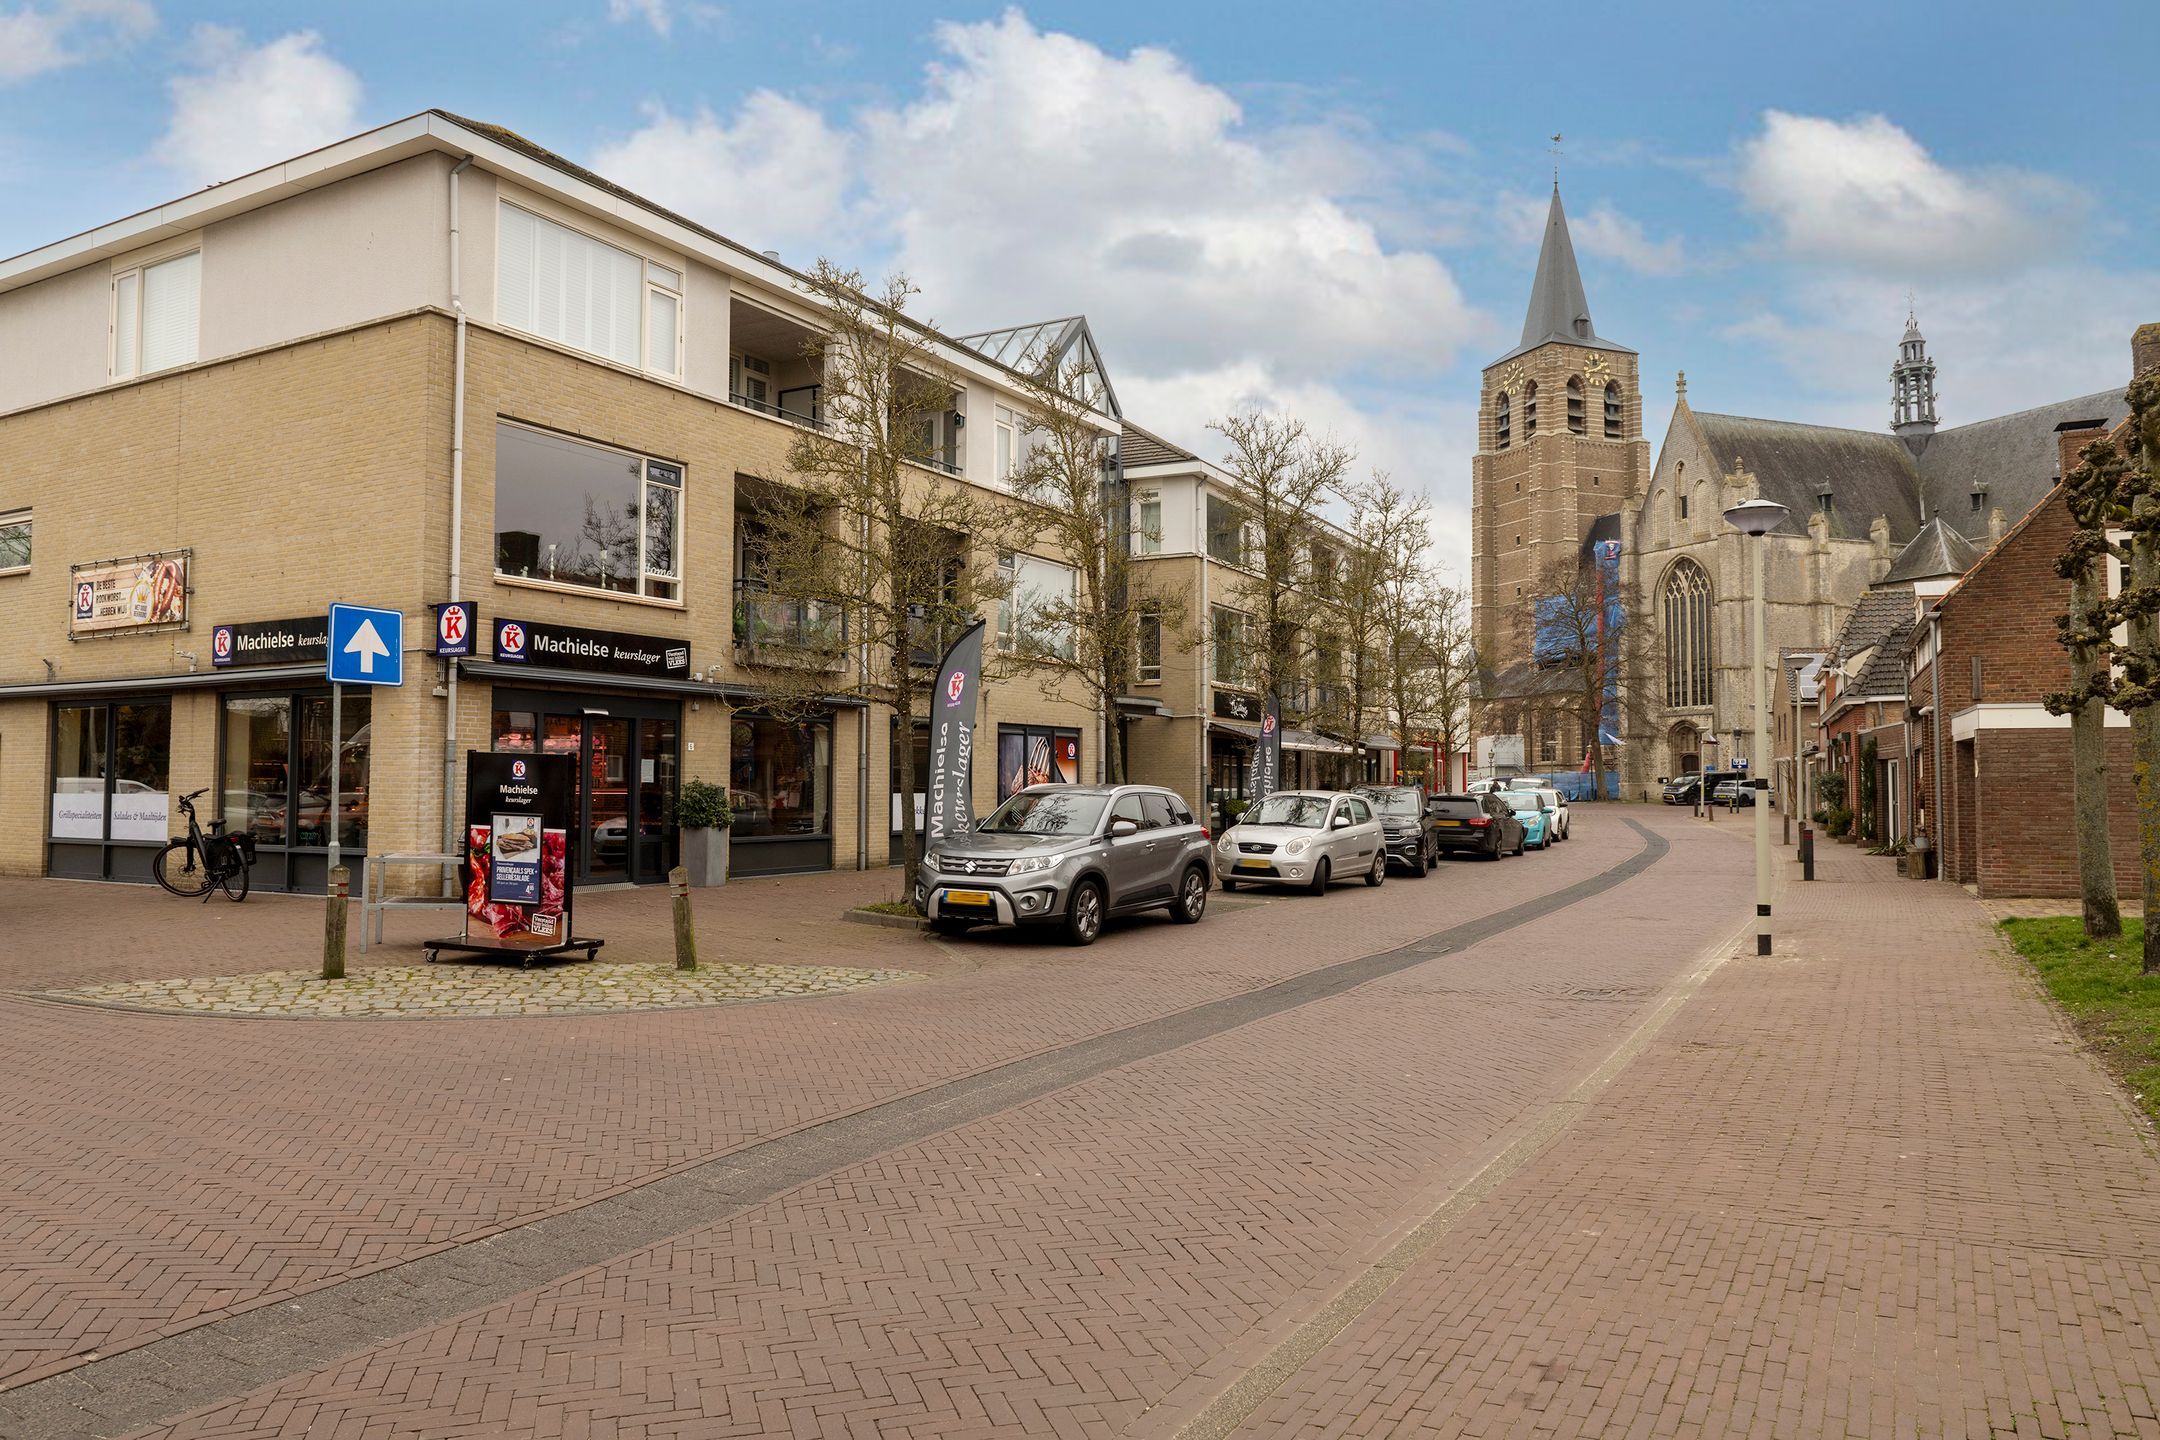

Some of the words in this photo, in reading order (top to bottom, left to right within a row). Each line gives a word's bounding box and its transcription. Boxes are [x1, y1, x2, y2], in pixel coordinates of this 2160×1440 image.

[96, 580, 102, 591] DE
[102, 579, 116, 590] BESTE
[80, 592, 90, 607] K
[445, 616, 462, 639] K
[217, 636, 228, 653] K
[237, 631, 294, 651] Machielse
[504, 631, 520, 649] K
[534, 634, 609, 658] Machielse
[613, 647, 661, 664] keurslager
[951, 680, 964, 697] K
[515, 764, 523, 774] K
[951, 721, 971, 834] keurslager
[931, 722, 949, 838] Machielse
[500, 785, 538, 795] Machielse
[505, 796, 532, 805] keurslager
[113, 811, 132, 820] Salades
[139, 811, 166, 822] Maaltijden
[524, 867, 534, 875] SPEK
